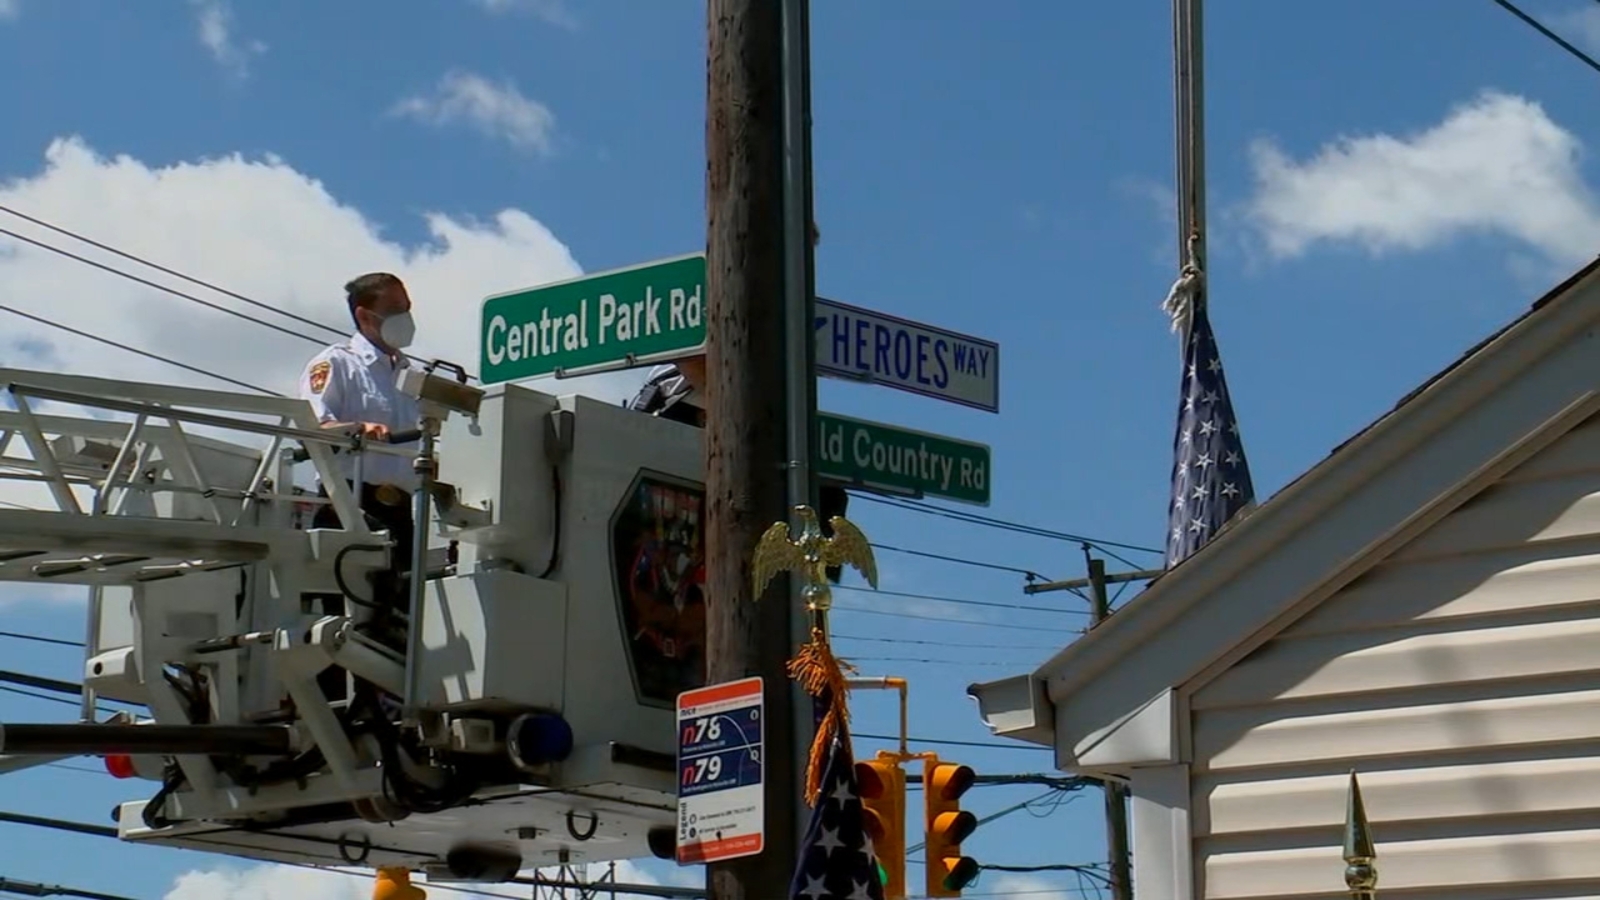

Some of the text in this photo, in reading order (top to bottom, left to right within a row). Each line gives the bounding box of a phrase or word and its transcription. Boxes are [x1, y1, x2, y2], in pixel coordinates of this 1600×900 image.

[486, 283, 702, 366] Central Park Rd
[832, 313, 990, 389] HEROES WAY
[819, 421, 985, 491] ld Country Rd
[682, 715, 721, 746] n78
[682, 755, 722, 786] n79
